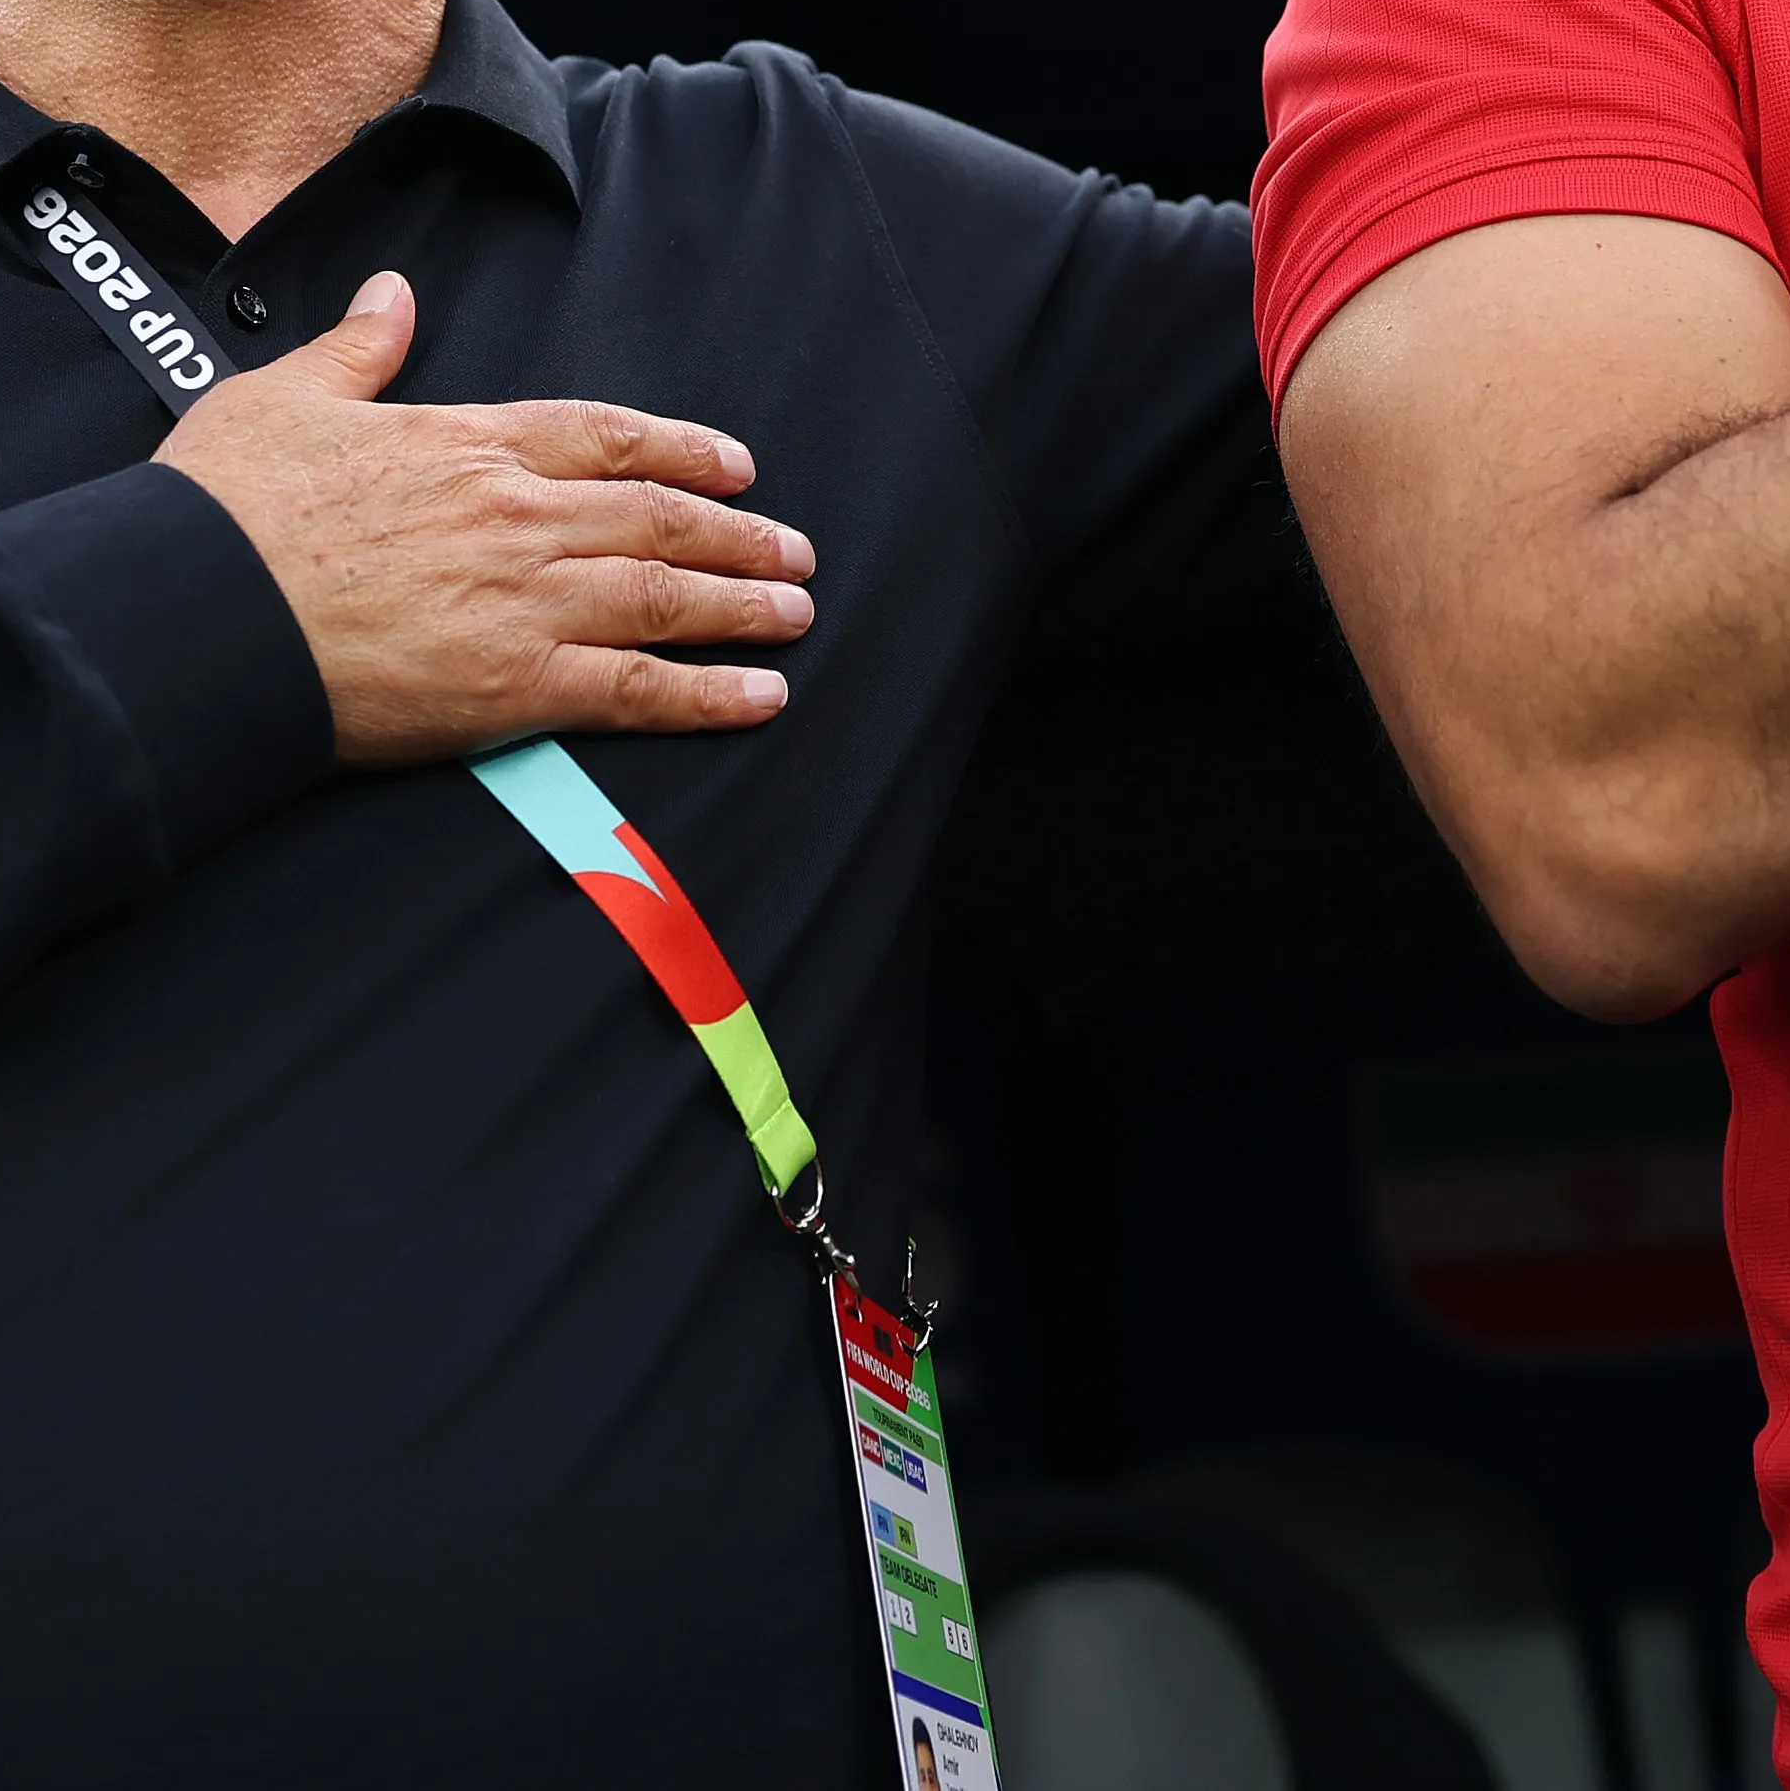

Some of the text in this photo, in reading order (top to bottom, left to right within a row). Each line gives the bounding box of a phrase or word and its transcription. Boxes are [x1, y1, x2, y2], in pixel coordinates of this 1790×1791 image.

[22, 185, 215, 391] CUP 2026
[845, 1338, 862, 1366] FIFA
[862, 1349, 890, 1385] WORLD
[889, 1369, 904, 1394] CUP
[904, 1378, 932, 1412] 2026
[862, 1433, 881, 1459] CANC
[882, 1445, 903, 1470] MEXC
[905, 1459, 924, 1484] USAC
[879, 1553, 939, 1599] TEAM DELEGATE
[905, 1606, 912, 1625] 2
[947, 1626, 954, 1645] 5
[961, 1633, 969, 1651] 6
